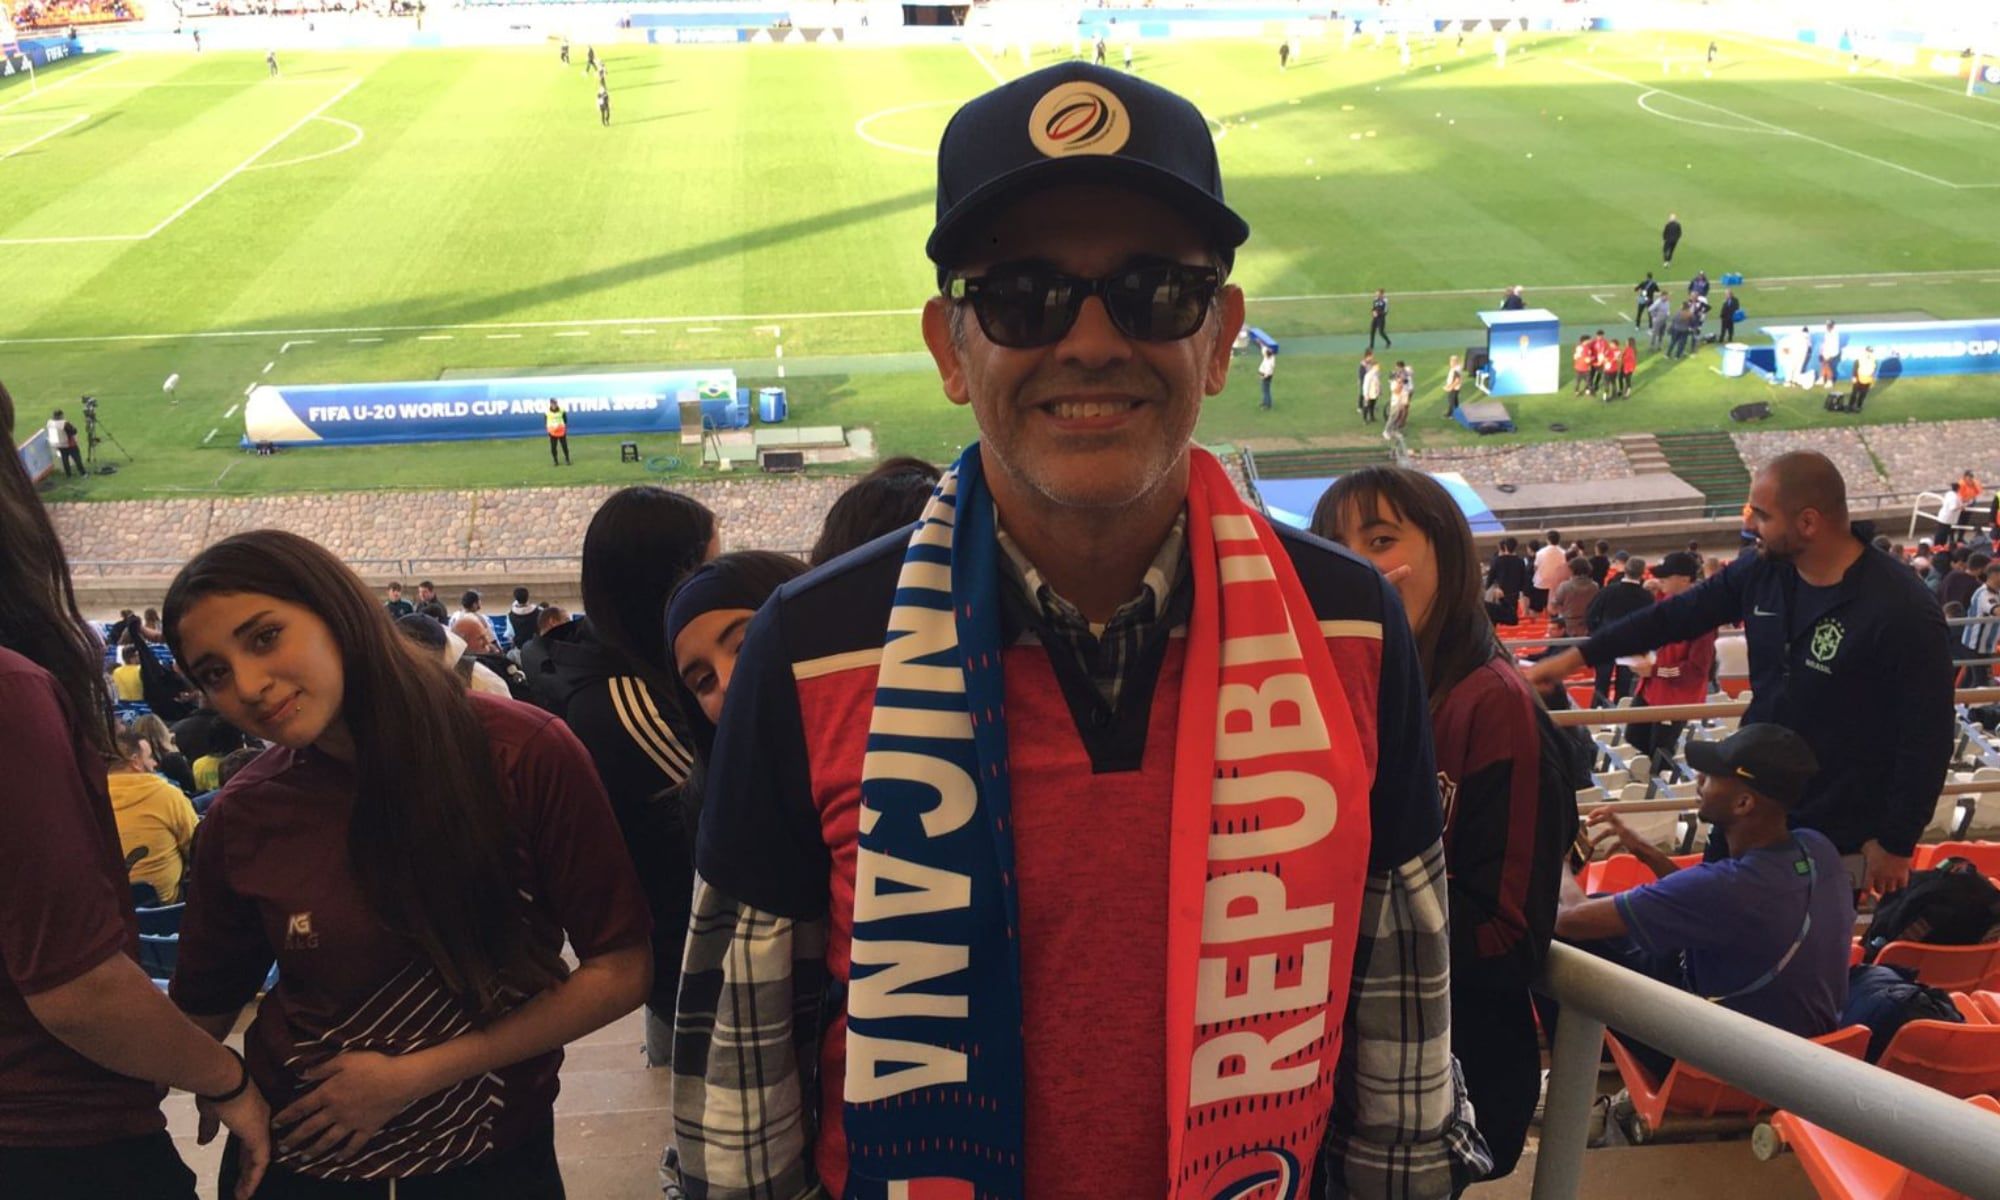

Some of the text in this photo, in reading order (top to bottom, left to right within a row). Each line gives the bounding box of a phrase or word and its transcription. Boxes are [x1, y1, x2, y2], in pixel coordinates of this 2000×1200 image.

[308, 406, 350, 422] FIFA
[353, 404, 396, 421] U-20
[399, 401, 469, 419] WORLD
[472, 399, 508, 416] CUP
